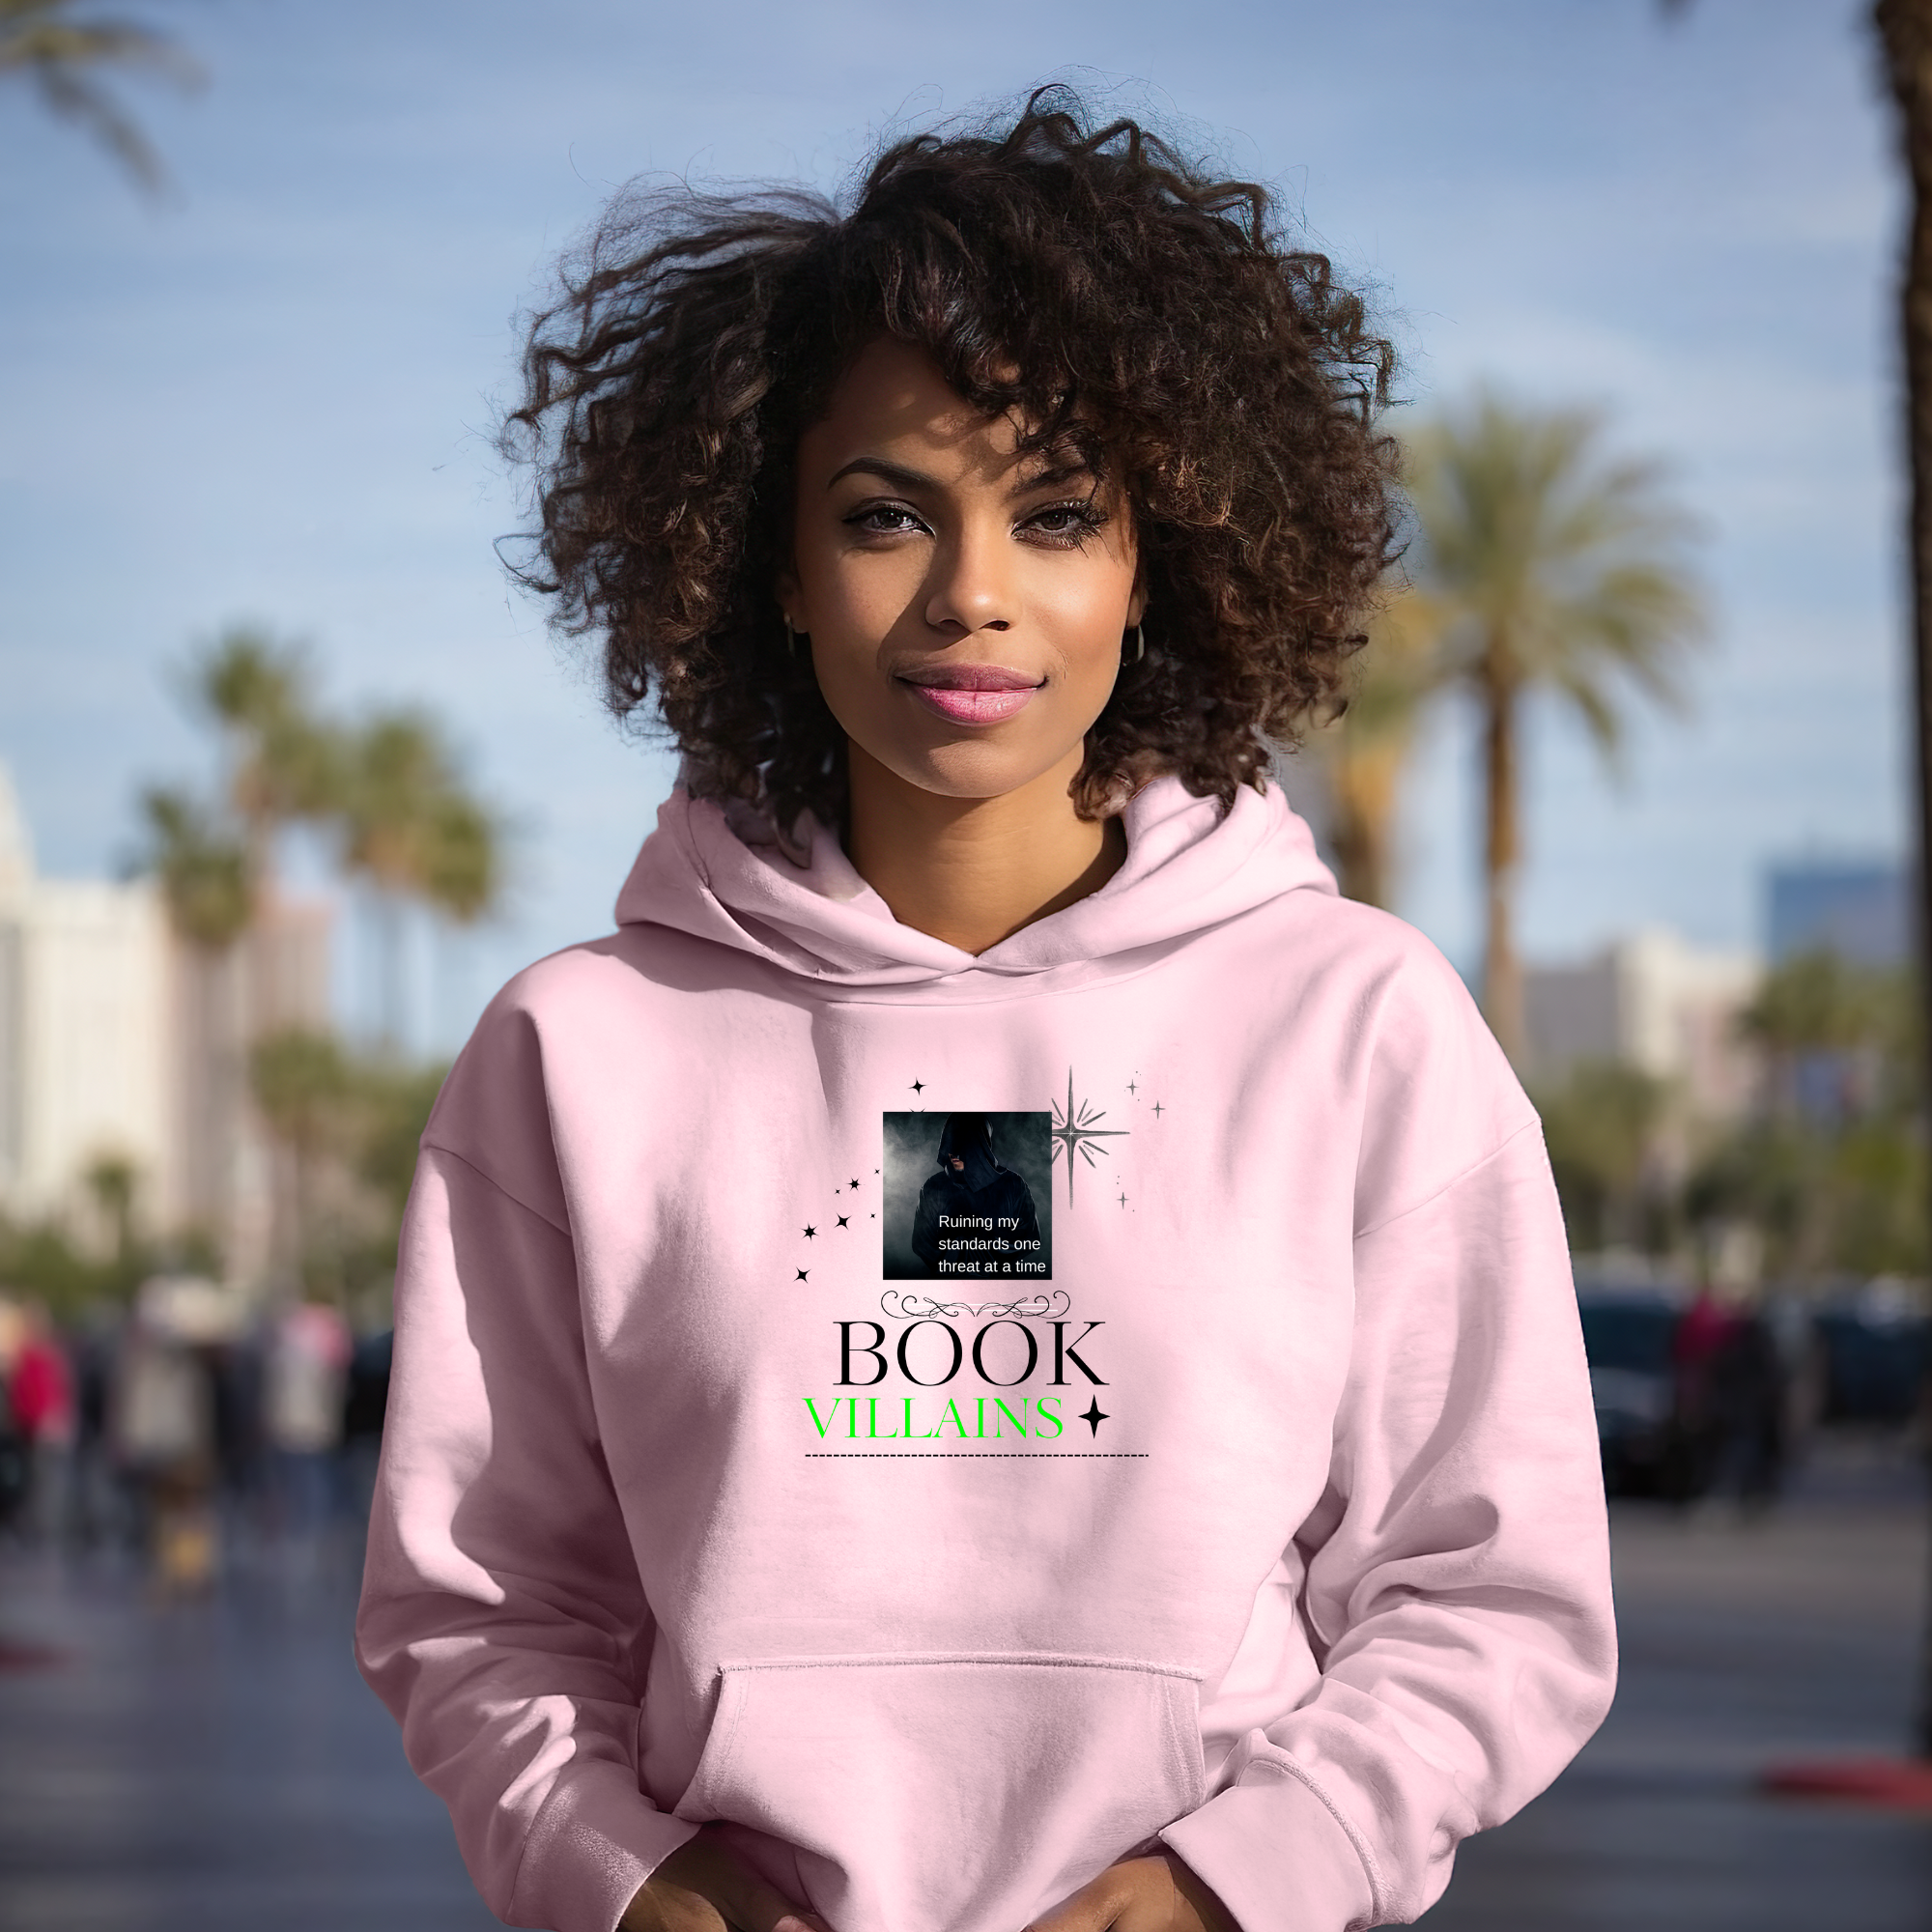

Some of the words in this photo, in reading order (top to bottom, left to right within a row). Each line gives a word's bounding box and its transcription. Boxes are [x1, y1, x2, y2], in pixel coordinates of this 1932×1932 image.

[940, 1215, 992, 1231] Ruining
[999, 1218, 1019, 1231] my
[939, 1237, 1009, 1250] standards
[1014, 1240, 1040, 1250] one
[939, 1260, 980, 1272] threat
[984, 1262, 998, 1272] at
[1003, 1263, 1011, 1272] a
[1016, 1260, 1045, 1272] time
[834, 1321, 1108, 1386] BOOK
[803, 1398, 1063, 1438] VILLAINS
